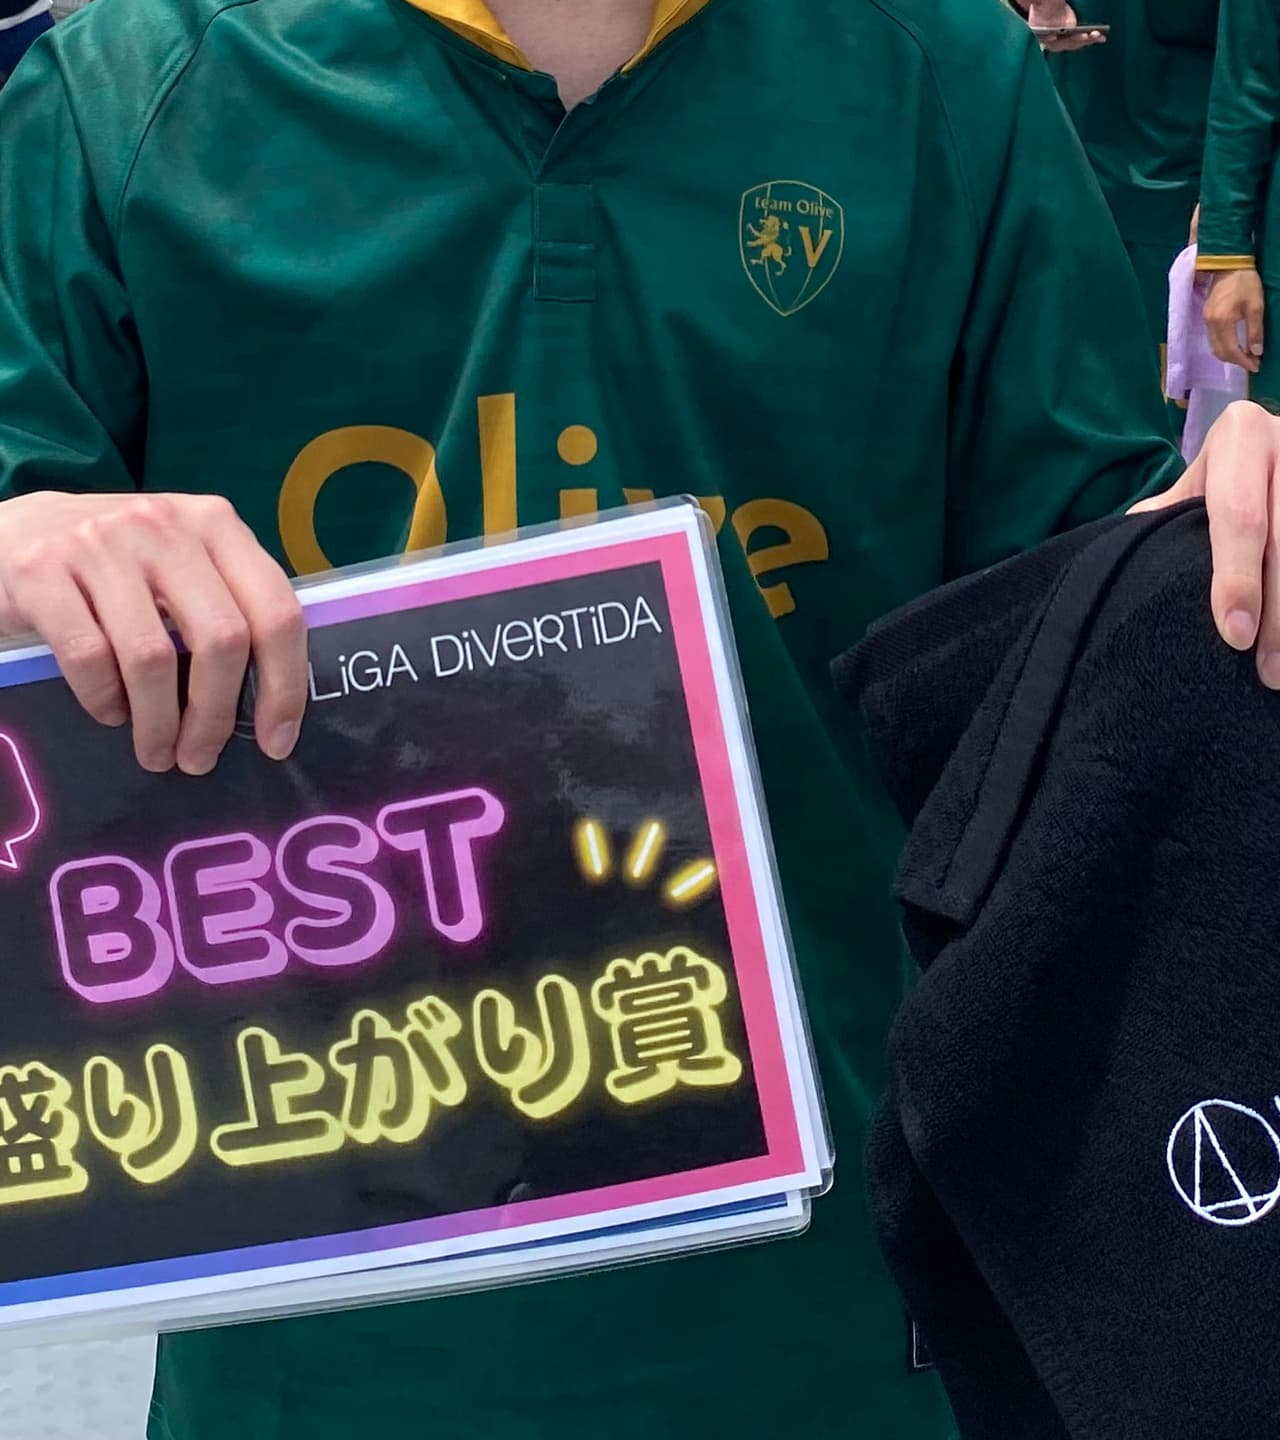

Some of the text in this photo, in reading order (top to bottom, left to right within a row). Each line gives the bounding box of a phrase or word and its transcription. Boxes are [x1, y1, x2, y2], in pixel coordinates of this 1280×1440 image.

[796, 199, 834, 219] Olive
[798, 225, 834, 267] V
[49, 787, 505, 1004] BEST
